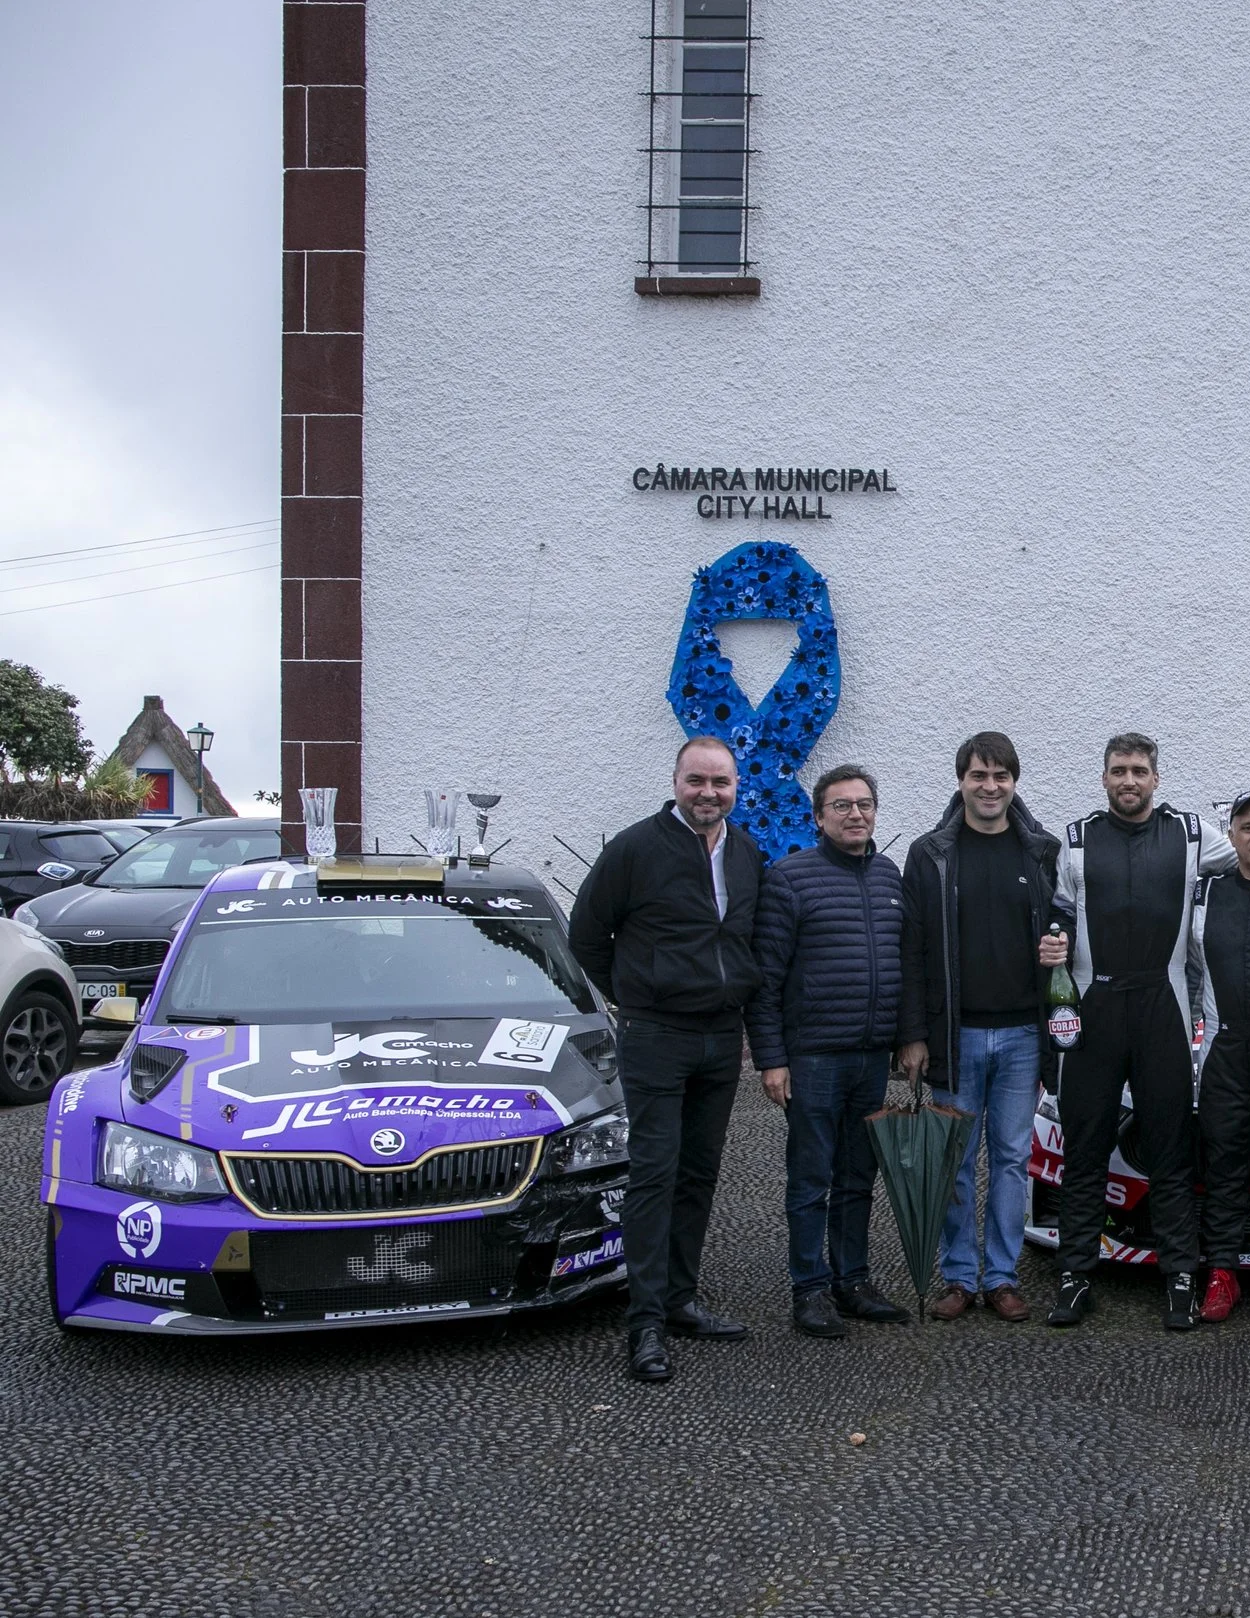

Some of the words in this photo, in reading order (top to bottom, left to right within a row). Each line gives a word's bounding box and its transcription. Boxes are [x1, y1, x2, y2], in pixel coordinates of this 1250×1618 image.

[633, 463, 747, 491] CÂMARA
[755, 468, 897, 492] MUNICIPAL
[697, 495, 756, 519] CITY
[763, 496, 832, 519] HALL
[281, 896, 344, 907] AUTO
[356, 893, 474, 904] MECÂNICA
[1051, 1020, 1079, 1032] CORAL
[493, 1052, 544, 1063] 6
[290, 1061, 351, 1075] AUTO
[363, 1057, 479, 1068] MECÂNICA
[342, 1111, 369, 1122] Auto
[371, 1108, 433, 1118] Bate-Chapa
[499, 1110, 521, 1119] LDA
[127, 1217, 150, 1236] NP
